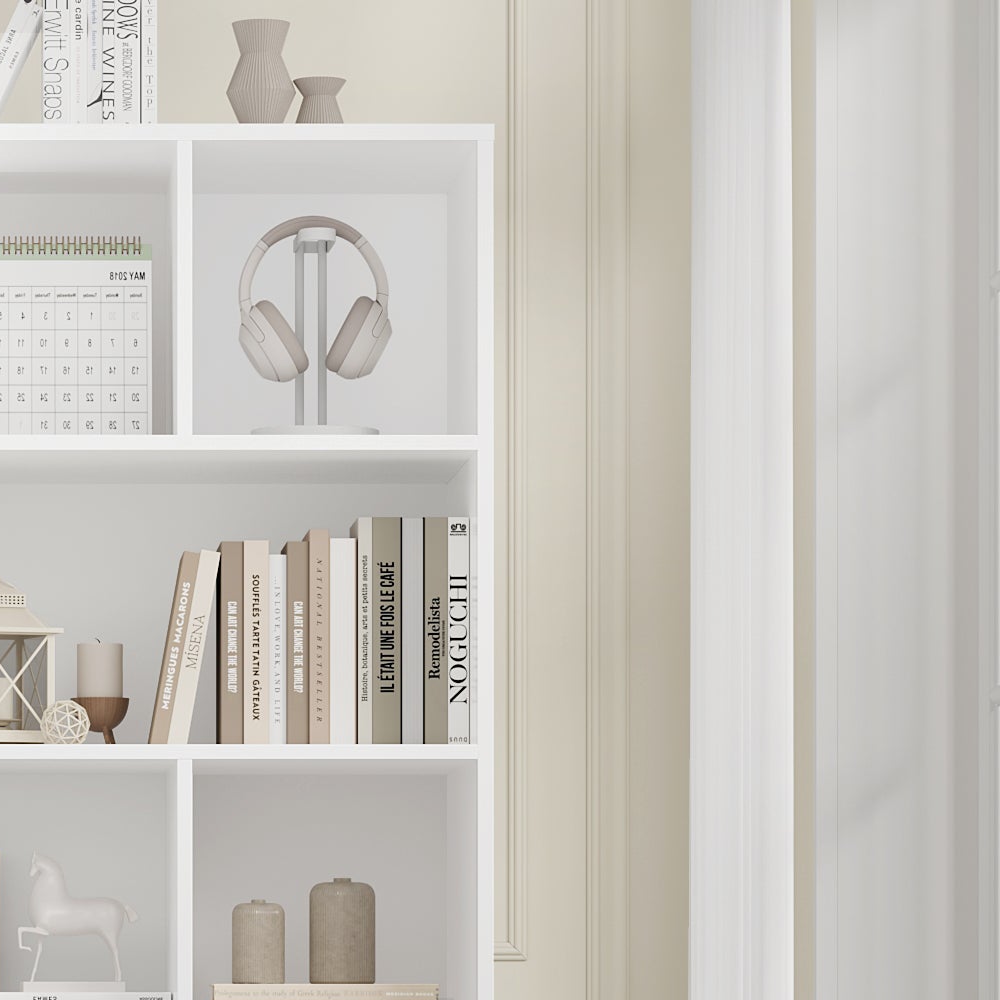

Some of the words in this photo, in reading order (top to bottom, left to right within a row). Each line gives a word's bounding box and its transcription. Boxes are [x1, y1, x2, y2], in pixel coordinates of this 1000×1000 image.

[75, 8, 83, 40] cardin
[43, 58, 69, 119] Snaps
[102, 47, 114, 120] WINES
[377, 562, 394, 587] CAFÉ
[227, 601, 237, 614] CAN
[252, 575, 261, 617] SOUFFLÉS
[380, 590, 394, 602] LE
[227, 616, 237, 627] ART
[380, 605, 394, 626] FOIS
[162, 646, 180, 709] MERINGUES
[173, 582, 191, 642] MACARONS
[227, 629, 237, 653] CHANGE
[252, 621, 260, 648] TARTE
[380, 630, 394, 650] UNE
[428, 597, 441, 679] Remodelista
[449, 576, 468, 704] NOGUCHI
[227, 655, 237, 666] THE
[252, 651, 260, 676] TATIN
[377, 653, 394, 681] ÉTAIT
[227, 668, 237, 693] WORLD?
[380, 684, 394, 693] IL
[252, 680, 262, 721] GÂTEAUX
